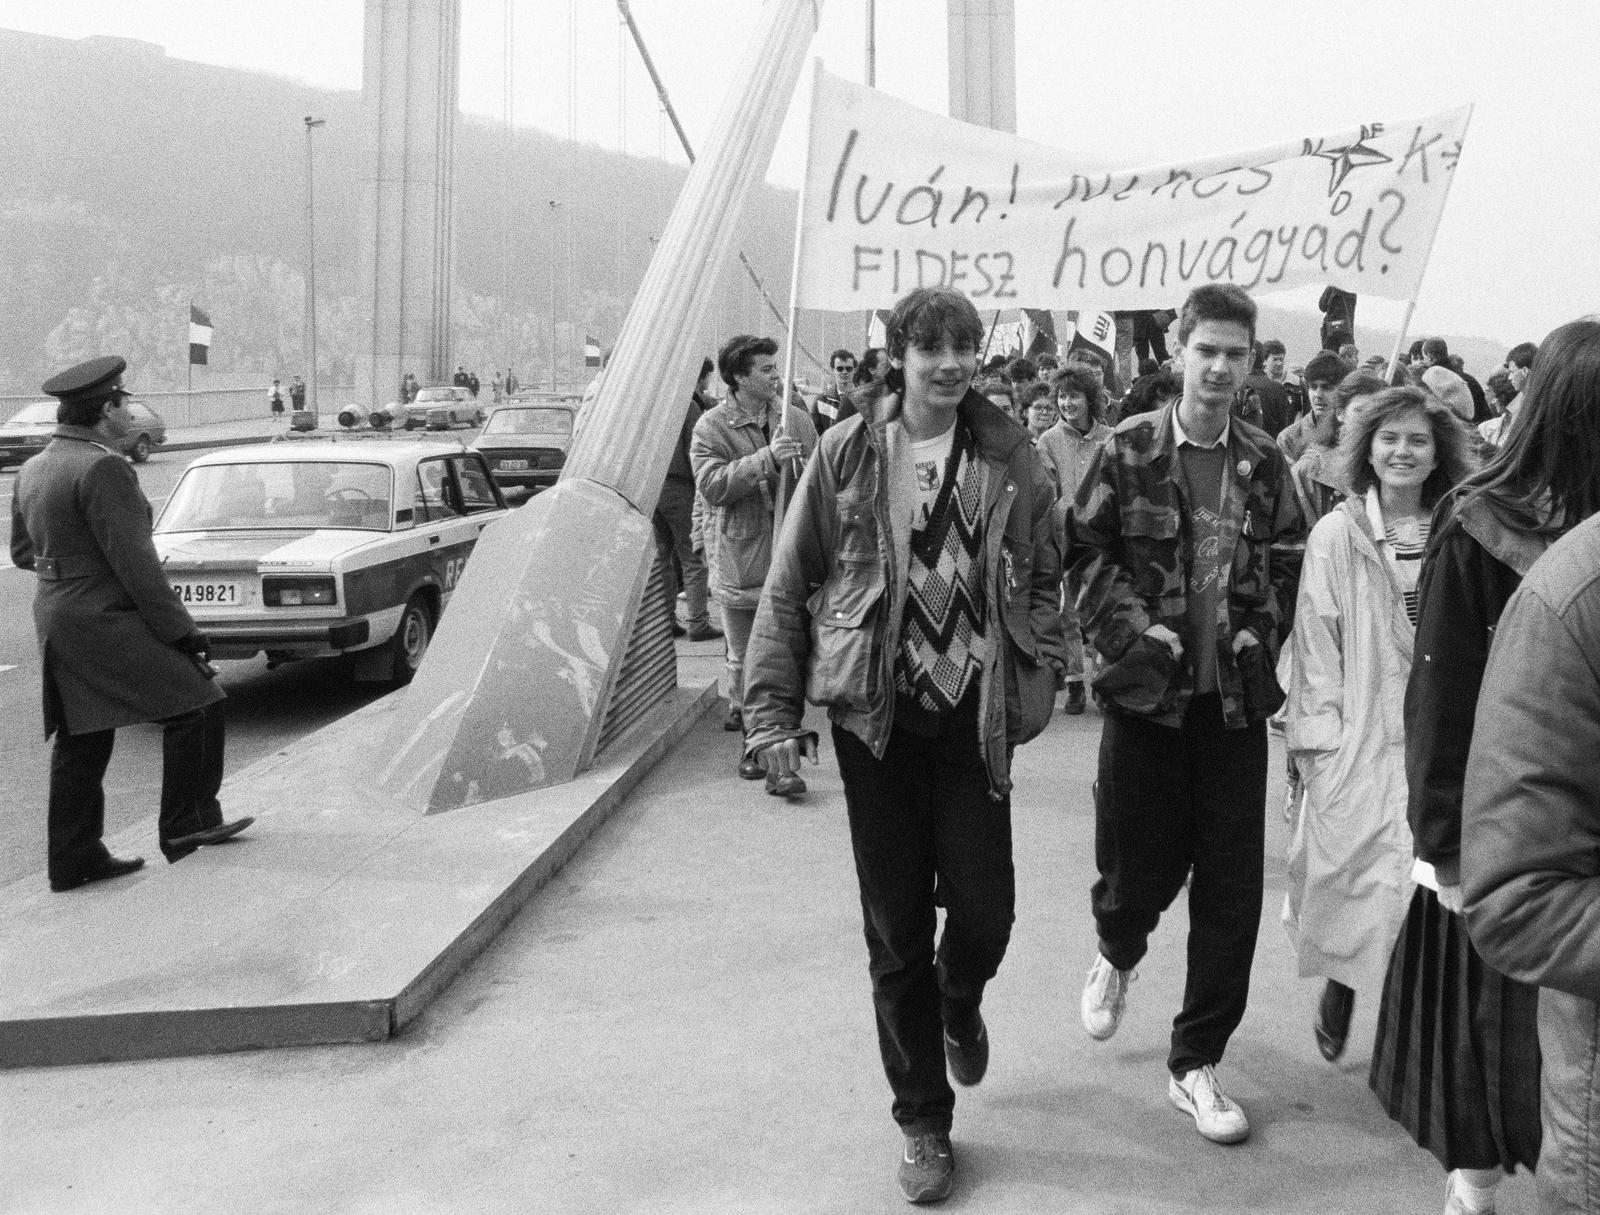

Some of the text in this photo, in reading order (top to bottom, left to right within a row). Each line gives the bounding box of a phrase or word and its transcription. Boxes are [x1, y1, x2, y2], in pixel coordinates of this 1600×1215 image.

[825, 128, 1019, 229] Iván!
[853, 244, 1018, 299] FIDESZ
[1052, 187, 1407, 291] honvágyad?
